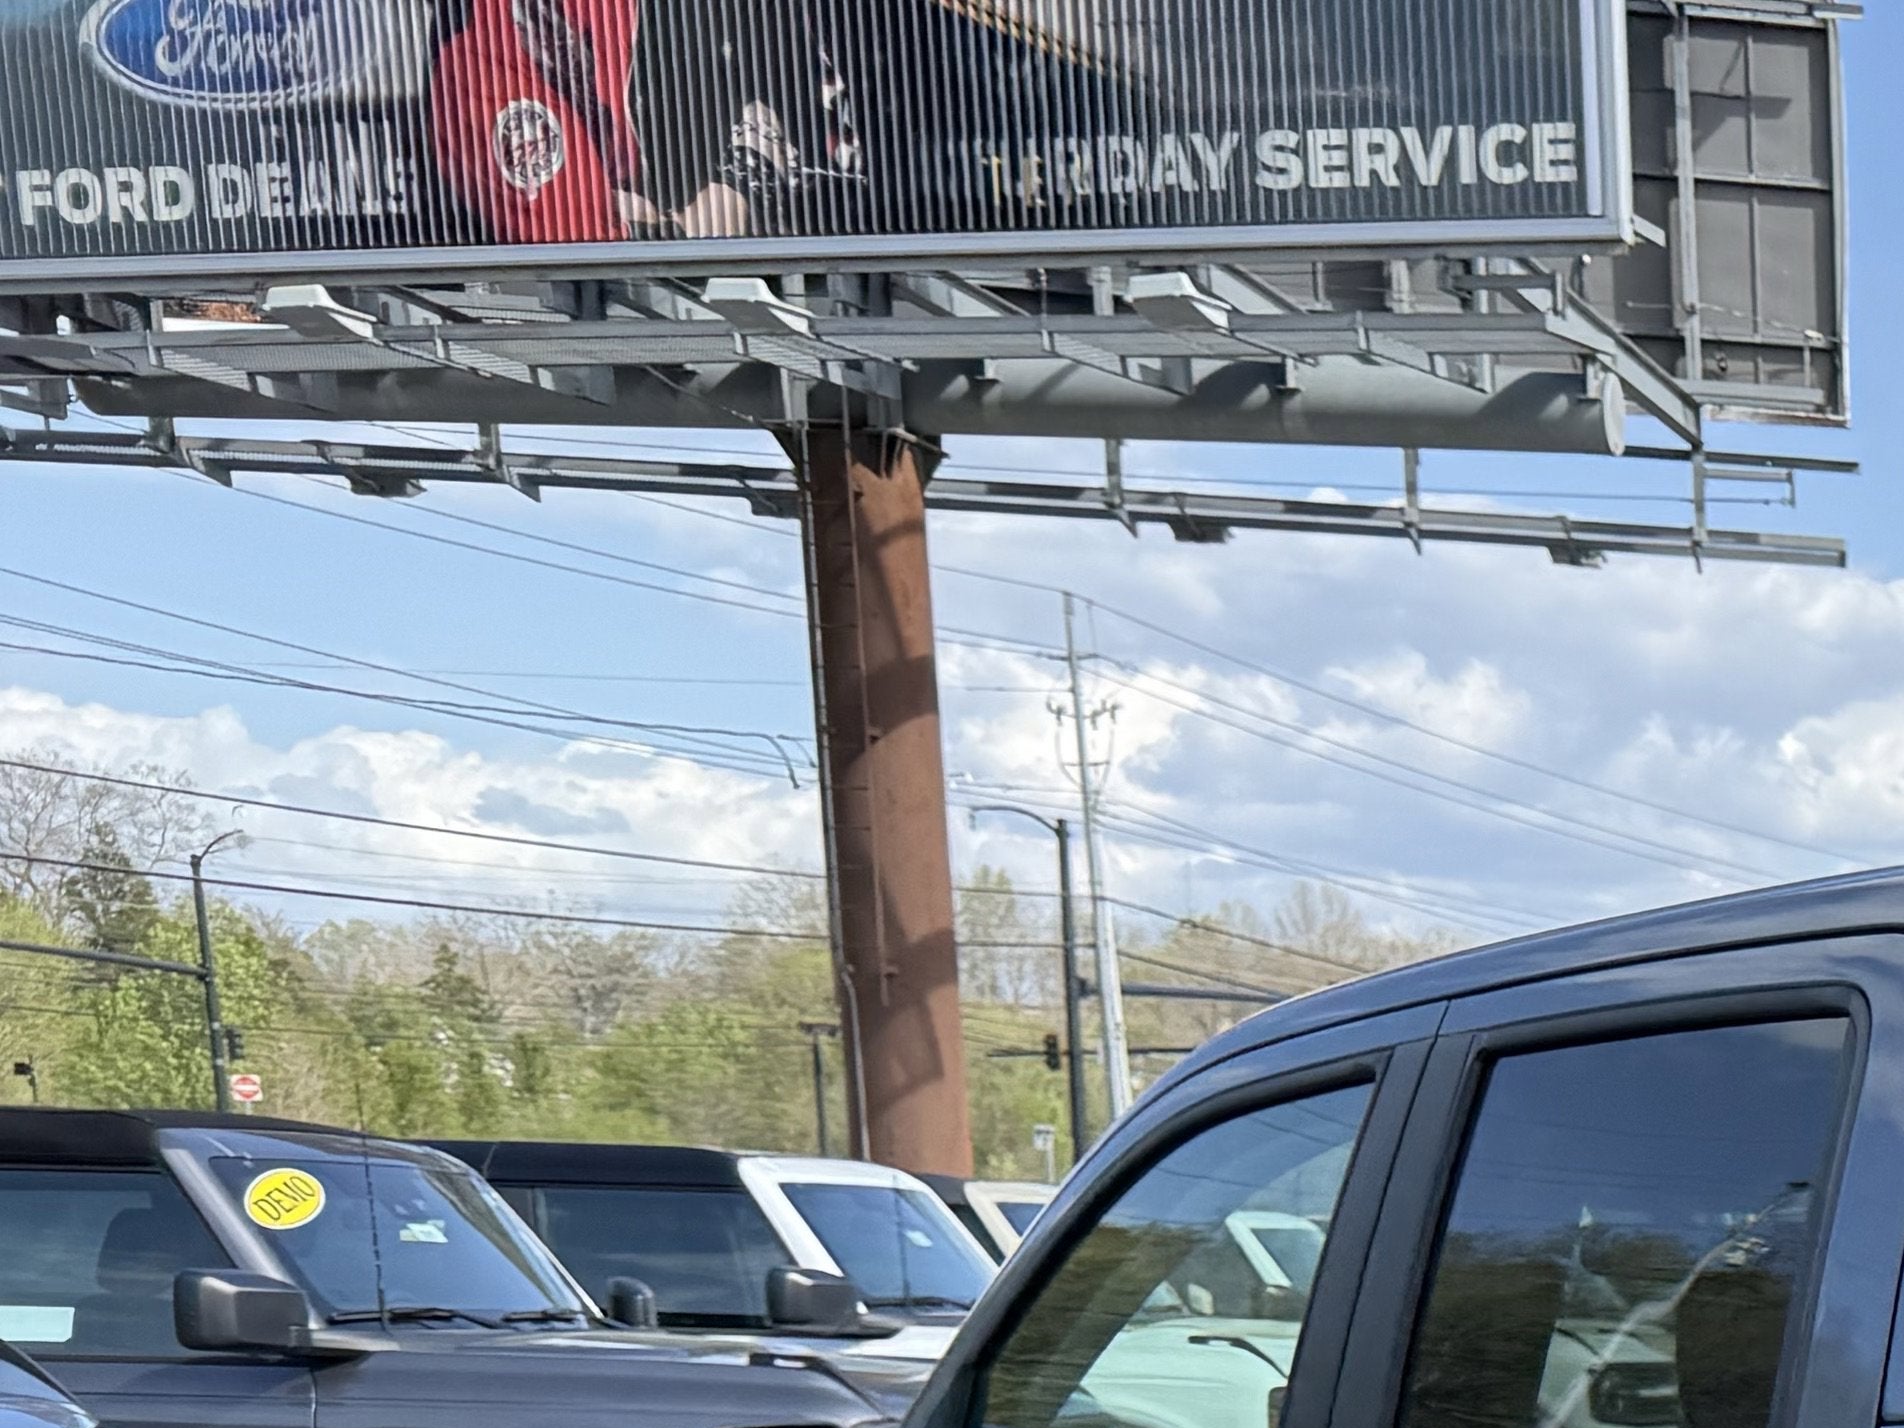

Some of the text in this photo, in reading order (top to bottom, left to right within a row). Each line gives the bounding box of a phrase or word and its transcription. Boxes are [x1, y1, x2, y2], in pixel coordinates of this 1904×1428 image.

[1254, 121, 1578, 190] SERVICE
[15, 163, 196, 226] FORD
[252, 1176, 316, 1221] DEMO
